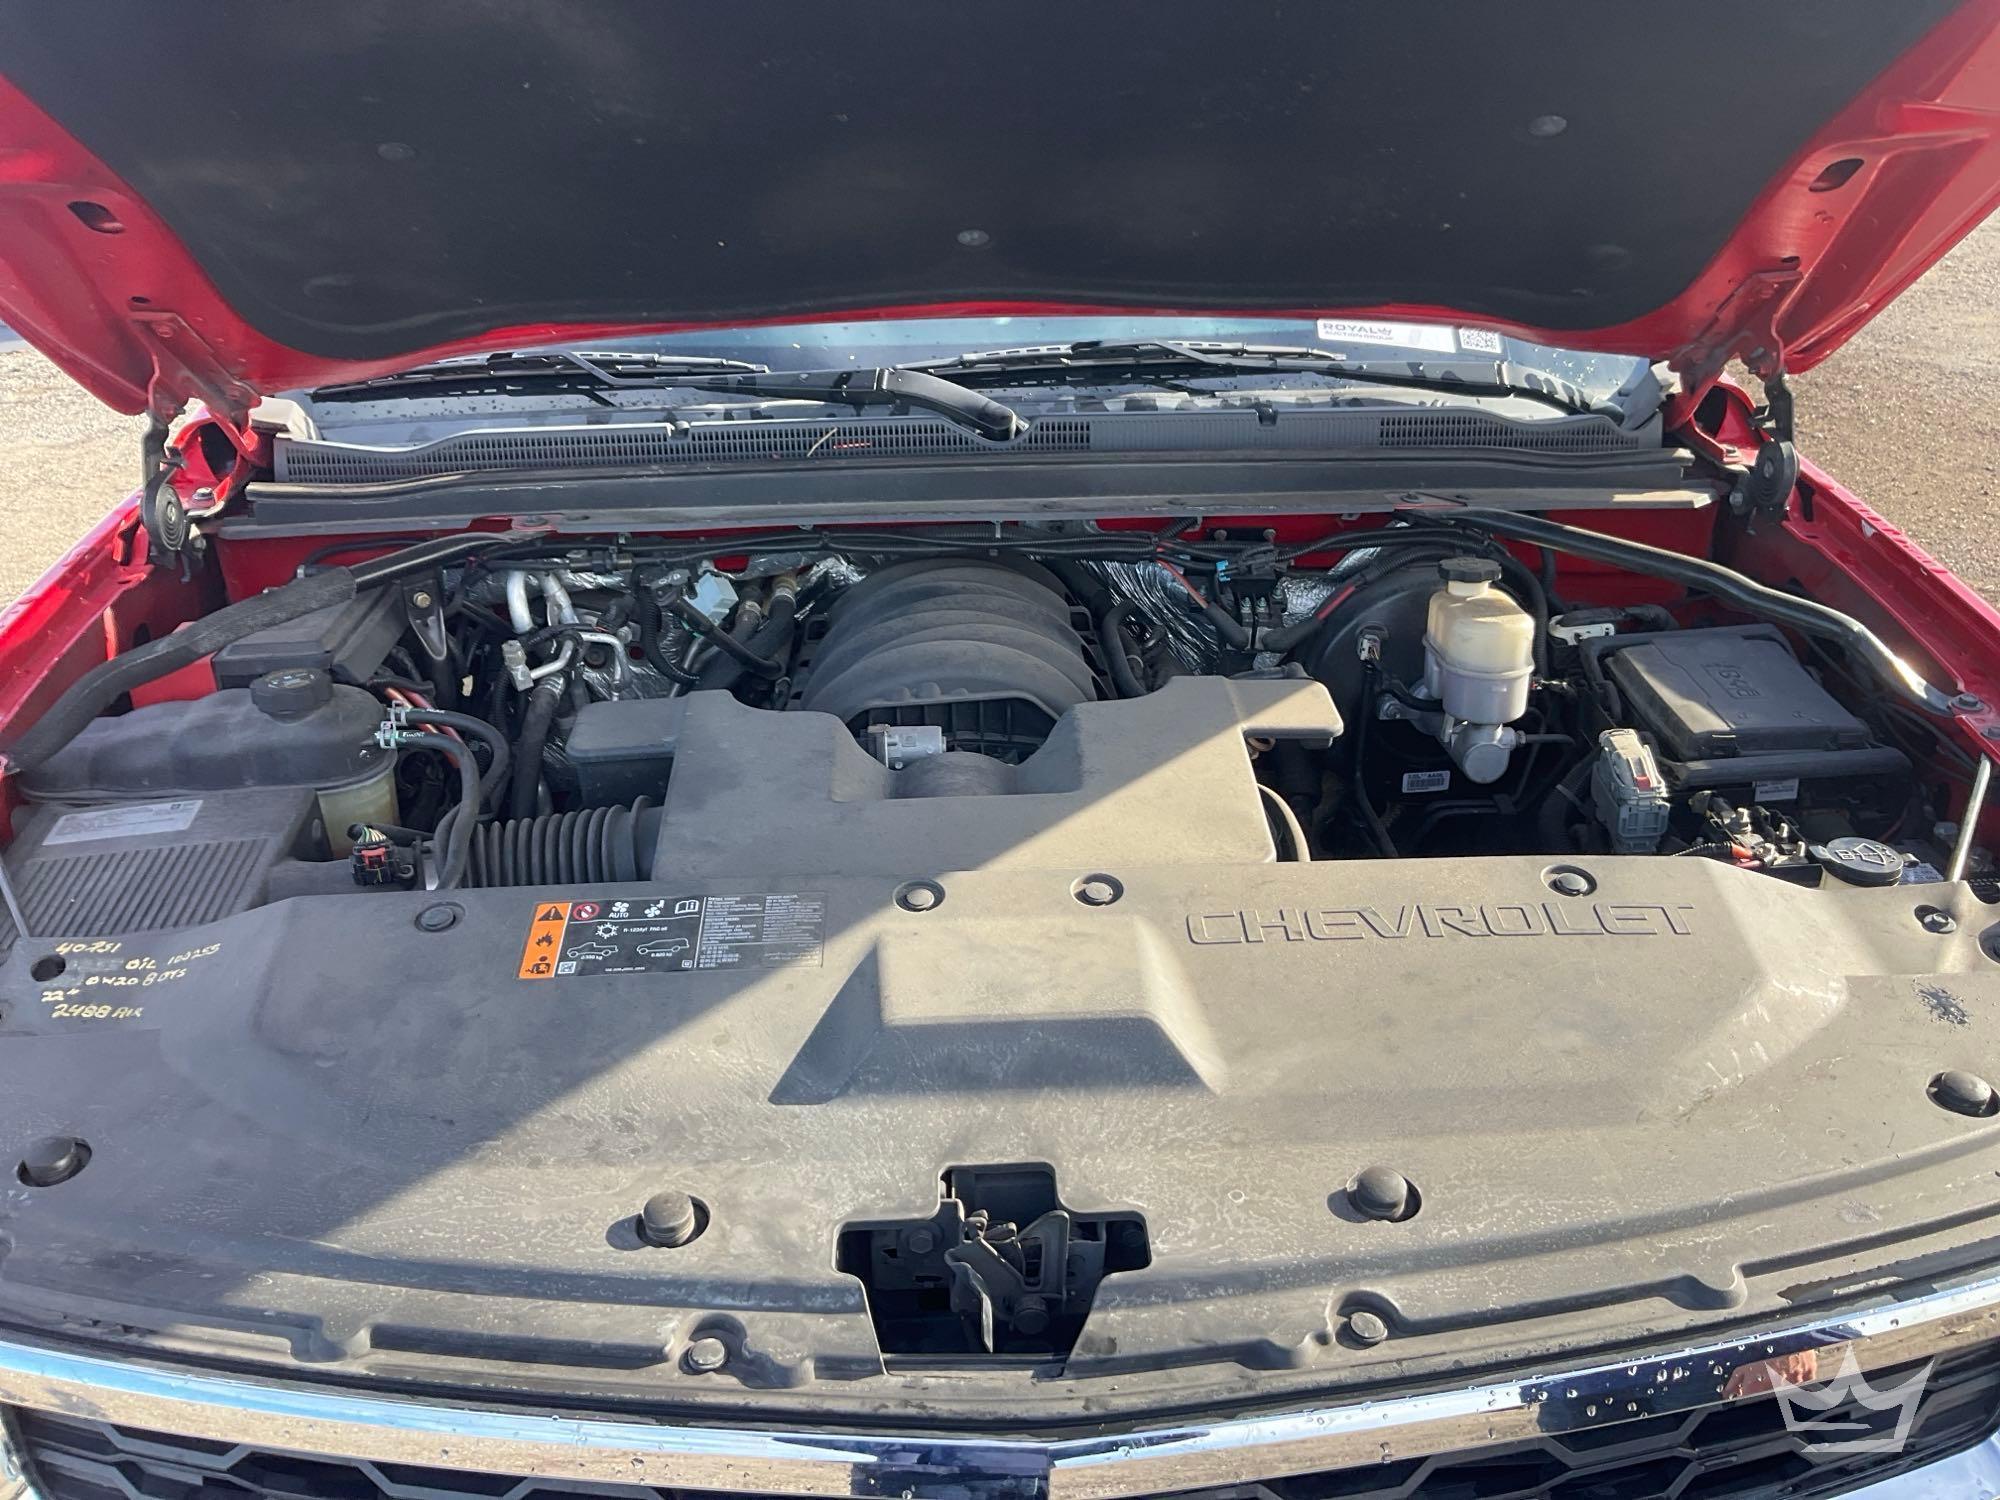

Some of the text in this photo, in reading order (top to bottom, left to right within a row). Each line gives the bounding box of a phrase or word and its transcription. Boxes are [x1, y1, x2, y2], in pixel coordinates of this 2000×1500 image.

[1323, 322, 1377, 334] ROYAL
[608, 911, 629, 919] AUTO
[1186, 902, 1694, 945] CHEVROLET
